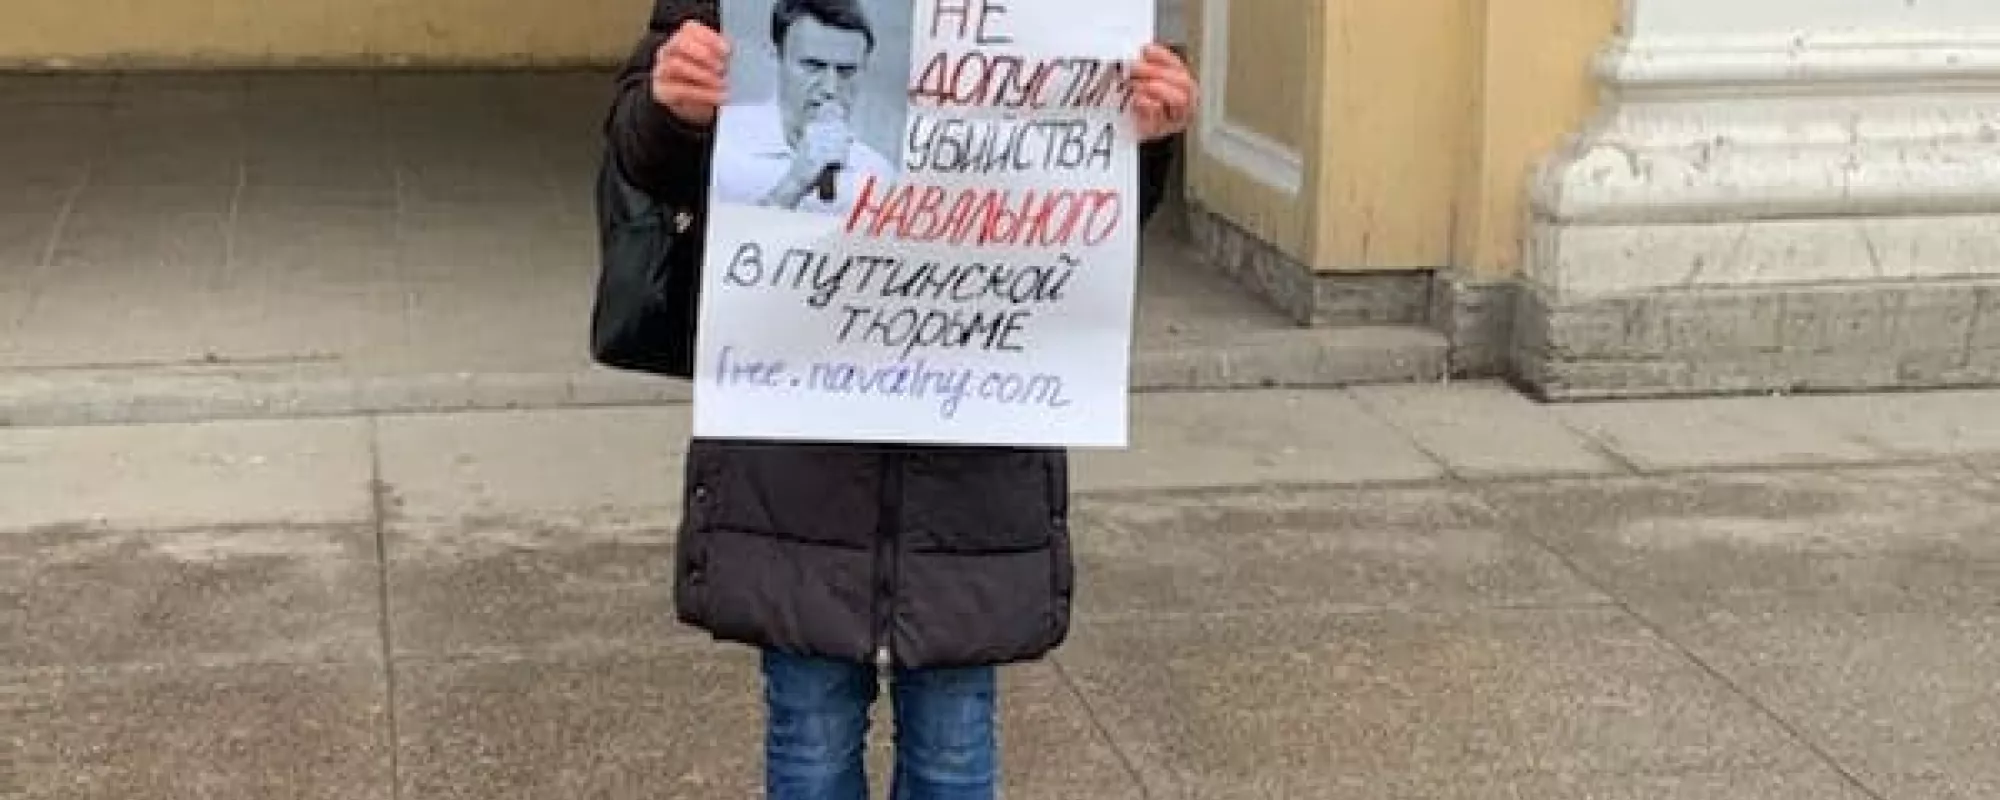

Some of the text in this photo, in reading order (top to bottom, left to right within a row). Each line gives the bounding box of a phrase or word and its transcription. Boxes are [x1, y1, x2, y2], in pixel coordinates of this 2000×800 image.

[930, 0, 1013, 44] НЕ
[906, 113, 1114, 174] УБИЙСТВА
[846, 175, 1120, 247] НАВАЛЬНОГО
[723, 242, 1080, 308] В ПУТИНСКОЙ
[836, 304, 1032, 358] ТЮРЬМЕ
